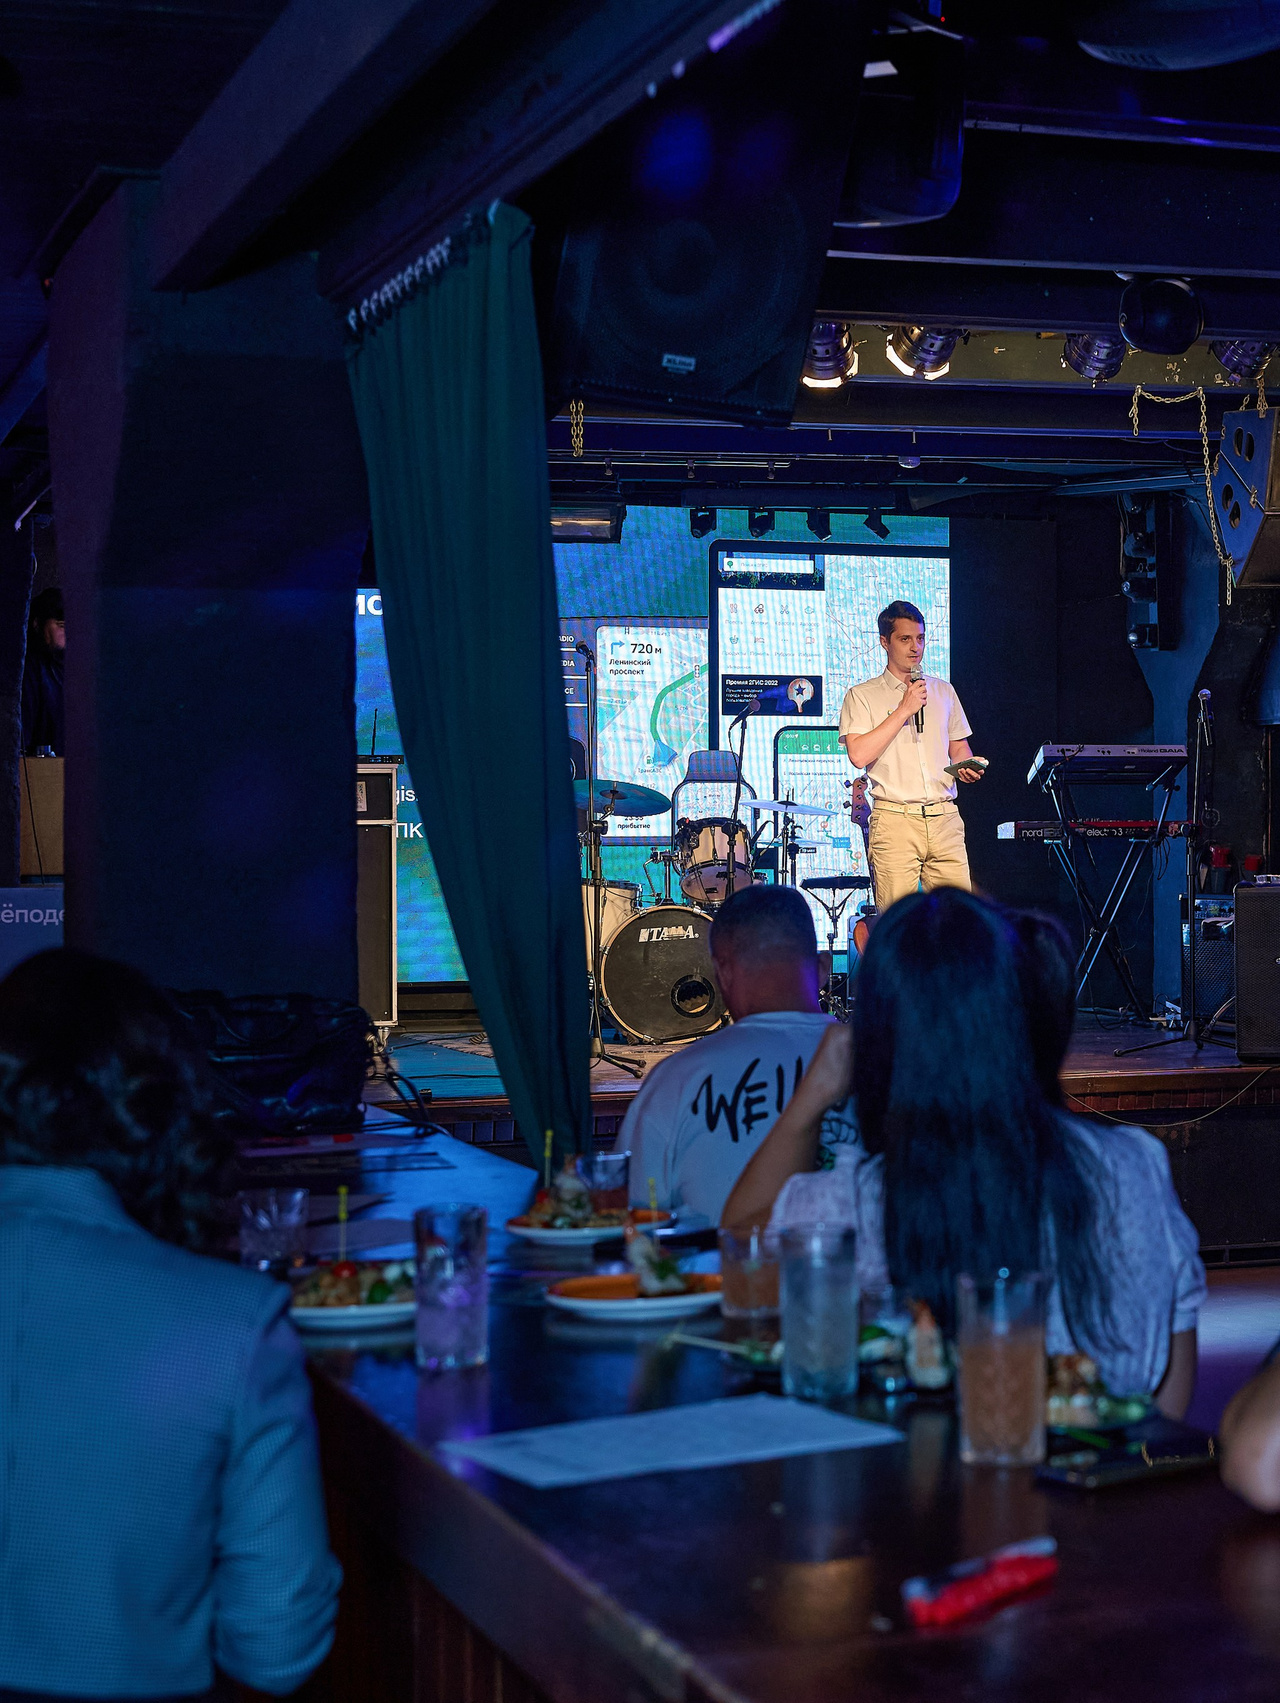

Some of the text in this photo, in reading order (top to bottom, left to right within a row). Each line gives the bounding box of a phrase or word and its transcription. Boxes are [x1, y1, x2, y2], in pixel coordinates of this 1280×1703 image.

[630, 643, 653, 654] 720
[609, 658, 651, 666] Ленинский
[609, 668, 644, 676] проспект
[1021, 828, 1043, 837] nord
